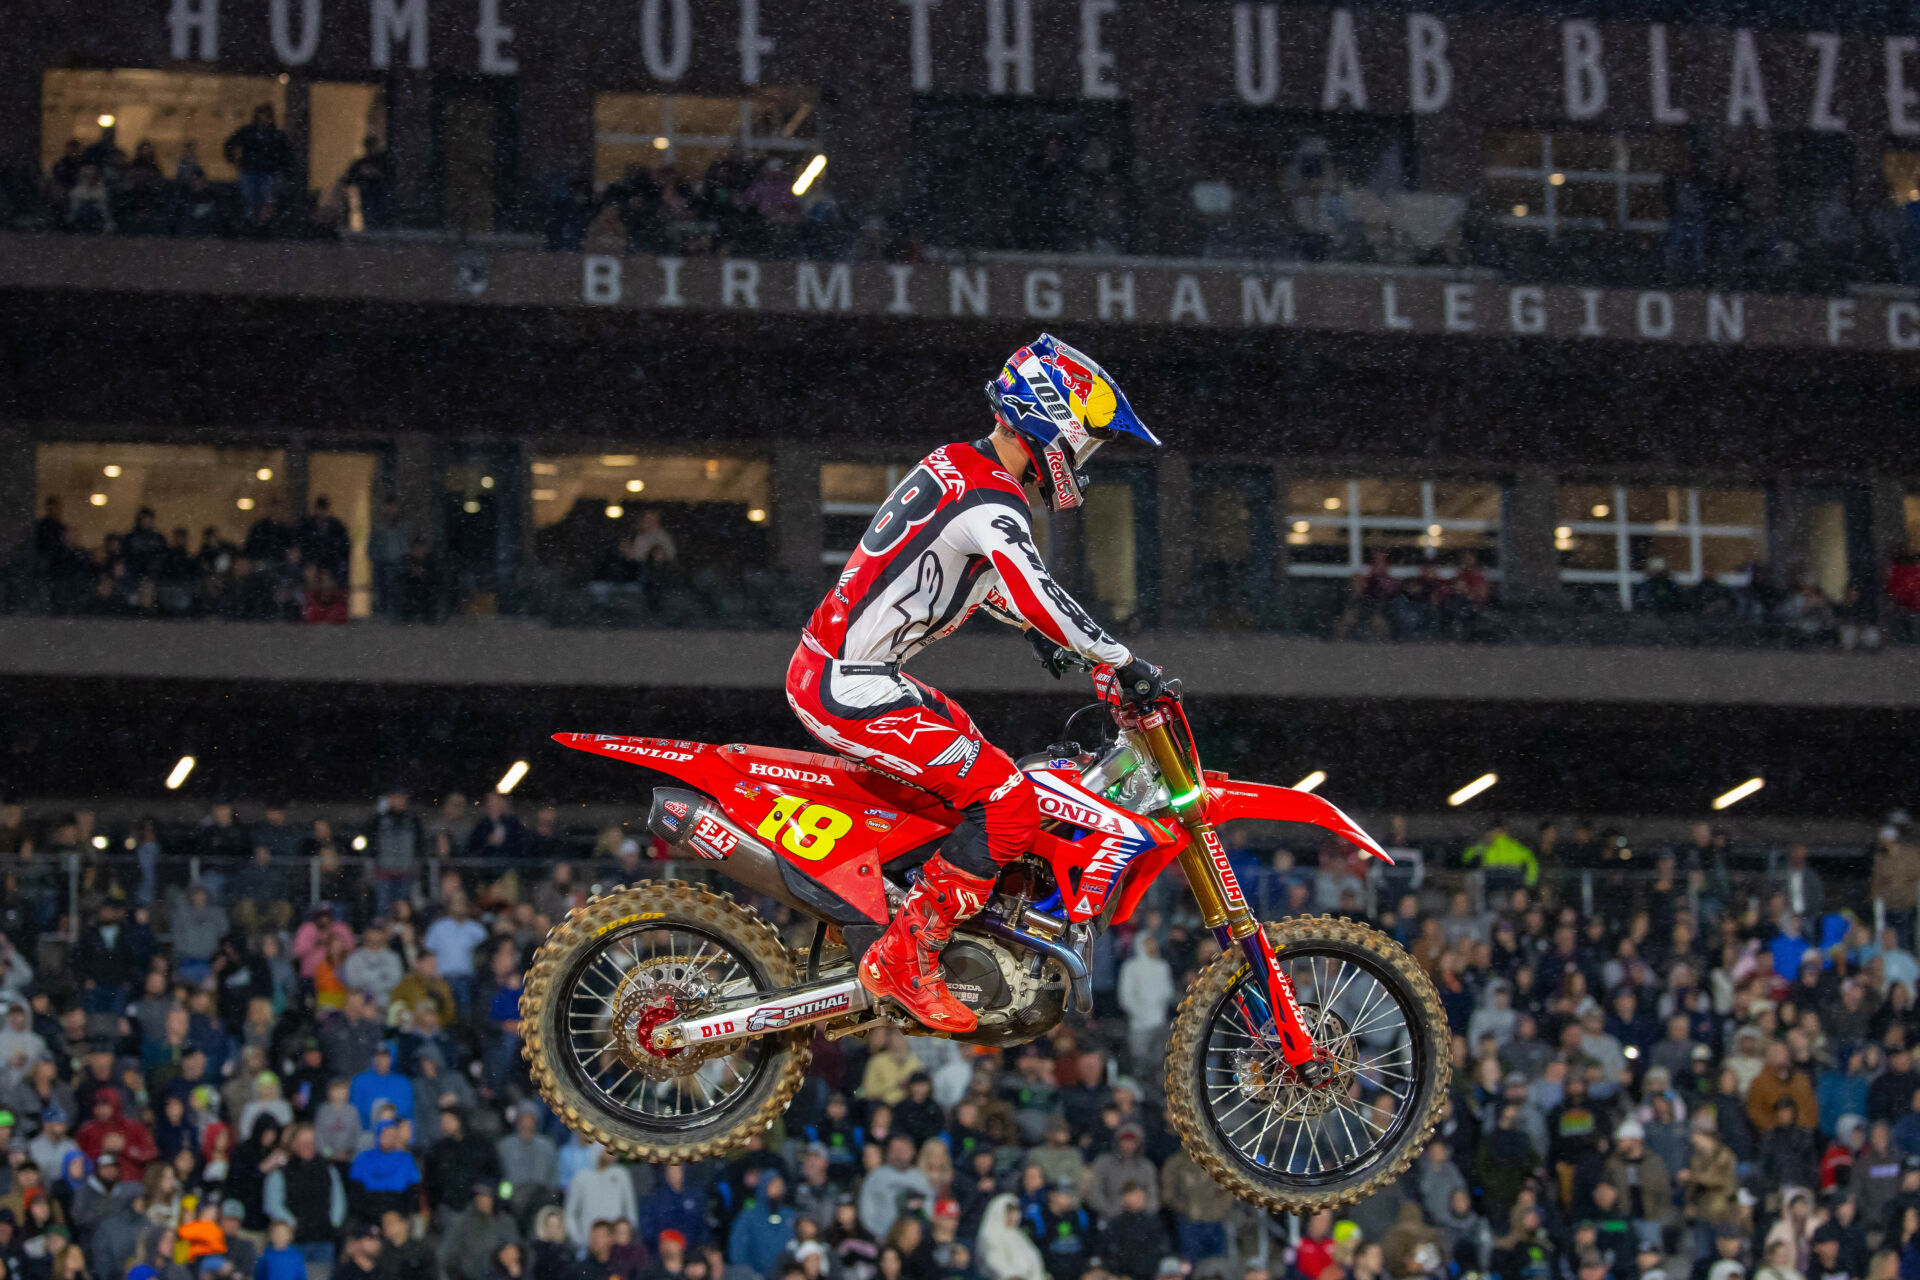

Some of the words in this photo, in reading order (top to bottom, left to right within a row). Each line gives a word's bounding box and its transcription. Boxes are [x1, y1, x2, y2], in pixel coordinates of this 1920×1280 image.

[168, 0, 520, 75] HOME
[641, 0, 773, 84] OF
[900, 0, 1119, 99] THE
[1232, 3, 1455, 114] UAB
[1562, 18, 1920, 137] BLAZE
[583, 255, 1296, 325] BIRMINGHAM
[1383, 280, 1746, 344] LEGION
[1827, 299, 1920, 350] FC
[927, 444, 966, 501] RENCE
[602, 743, 694, 762] DUNLOP
[957, 739, 980, 778] HONDA
[748, 762, 835, 787] HONDA
[695, 817, 738, 853] ヨシムラ
[756, 794, 853, 861] 18
[1038, 793, 1125, 835] ONDA
[1083, 837, 1142, 873] CRF
[1202, 830, 1243, 902] SHOWA
[596, 912, 665, 937] DUNLOP
[1269, 957, 1311, 1038] DUNLOP
